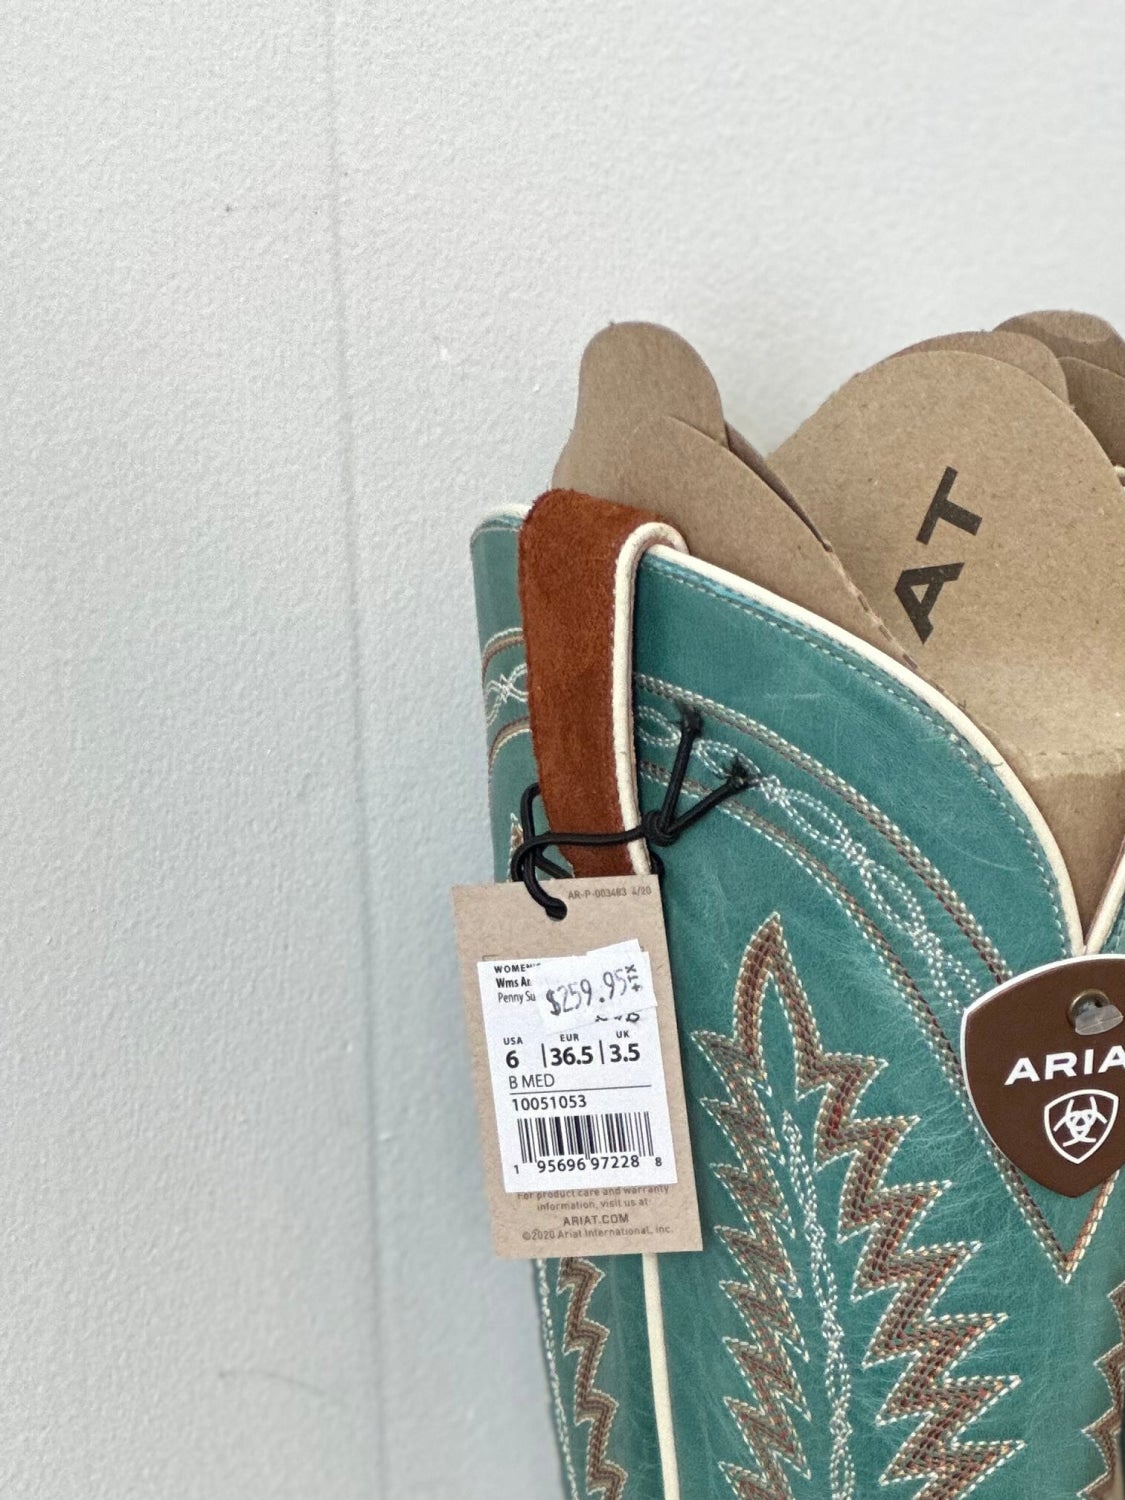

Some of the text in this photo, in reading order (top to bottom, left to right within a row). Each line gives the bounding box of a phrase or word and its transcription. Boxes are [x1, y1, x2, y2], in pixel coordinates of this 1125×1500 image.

[496, 976, 519, 989] Wms
[498, 992, 524, 1005] Penny
[546, 968, 627, 1017] $259.95
[503, 1030, 630, 1046] USA EUR UK
[506, 1043, 641, 1068] 6 36.5 3.5
[508, 1073, 555, 1089] B MED
[512, 1094, 587, 1111] 10051053
[513, 1154, 663, 1175] 1 95696 97228 8
[624, 1199, 637, 1207] us
[563, 1213, 629, 1226] ARIAT.COM
[557, 1229, 582, 1239] Ariat
